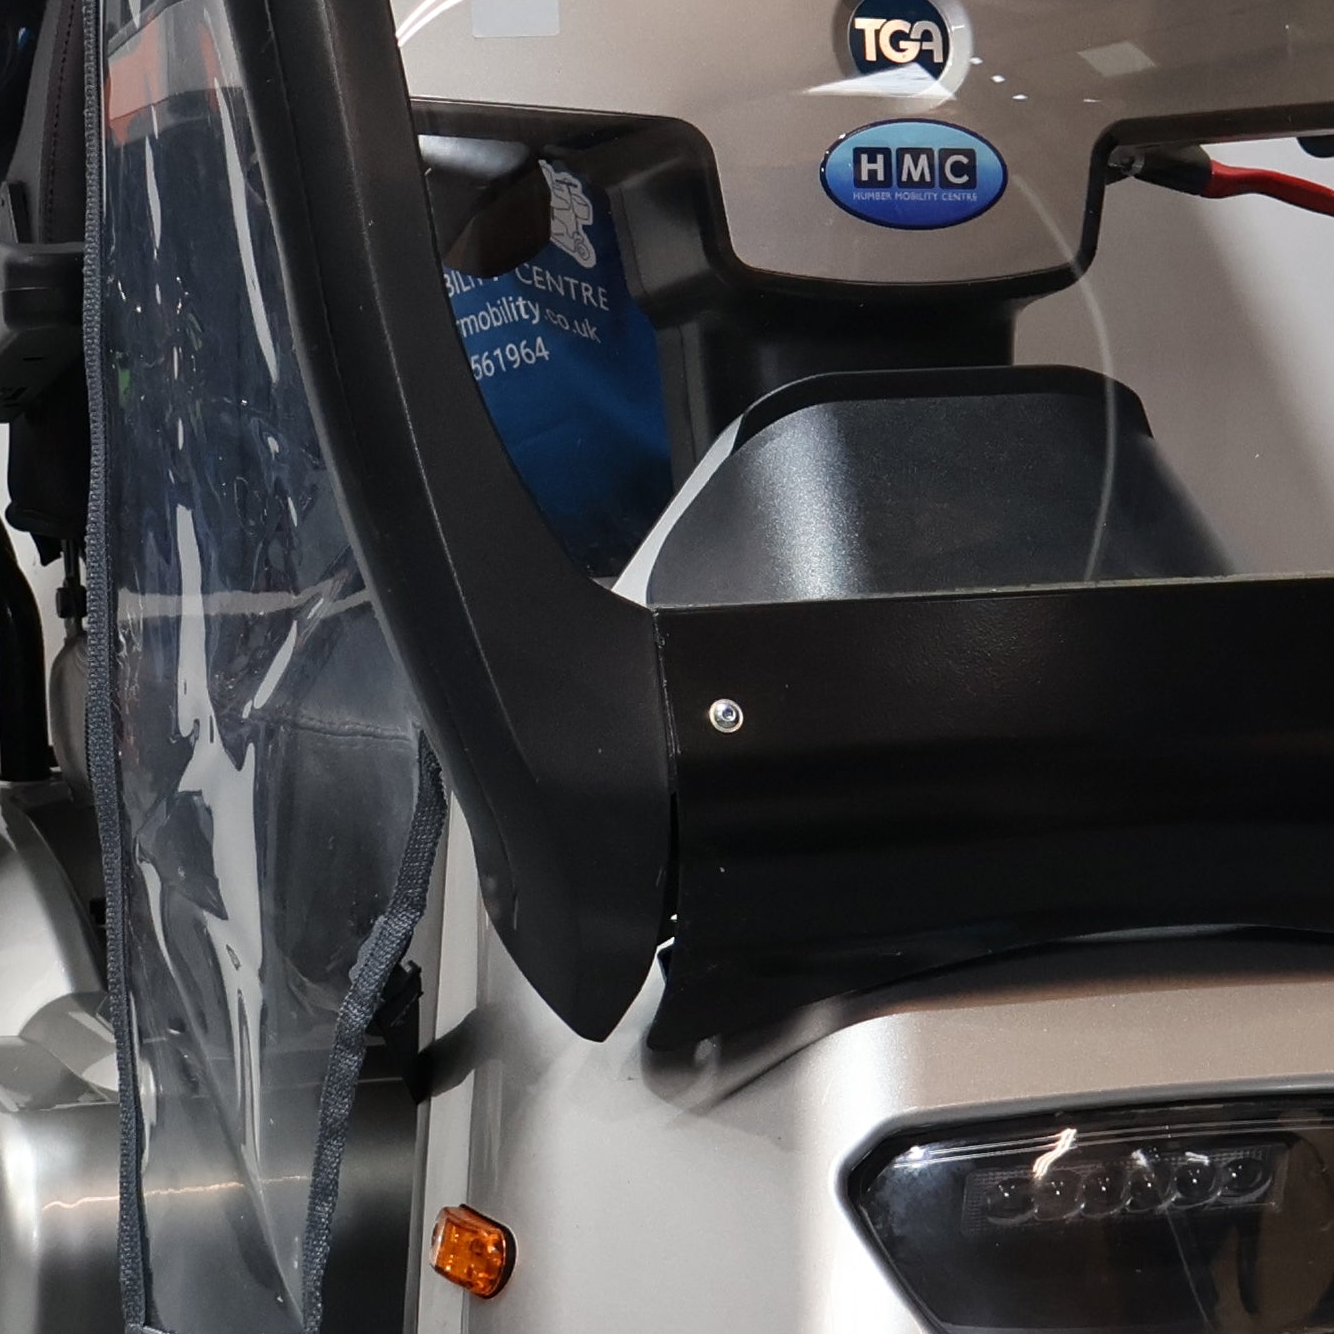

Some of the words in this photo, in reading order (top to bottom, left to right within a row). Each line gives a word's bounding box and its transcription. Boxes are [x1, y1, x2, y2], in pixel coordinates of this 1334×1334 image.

[853, 17, 944, 64] TGA
[858, 152, 971, 185] HMC
[852, 191, 892, 201] HUMBER
[894, 191, 938, 202] MOBILITY
[941, 192, 978, 202] CENTRE
[514, 262, 610, 312] CENTRE
[470, 336, 550, 381] 561964
